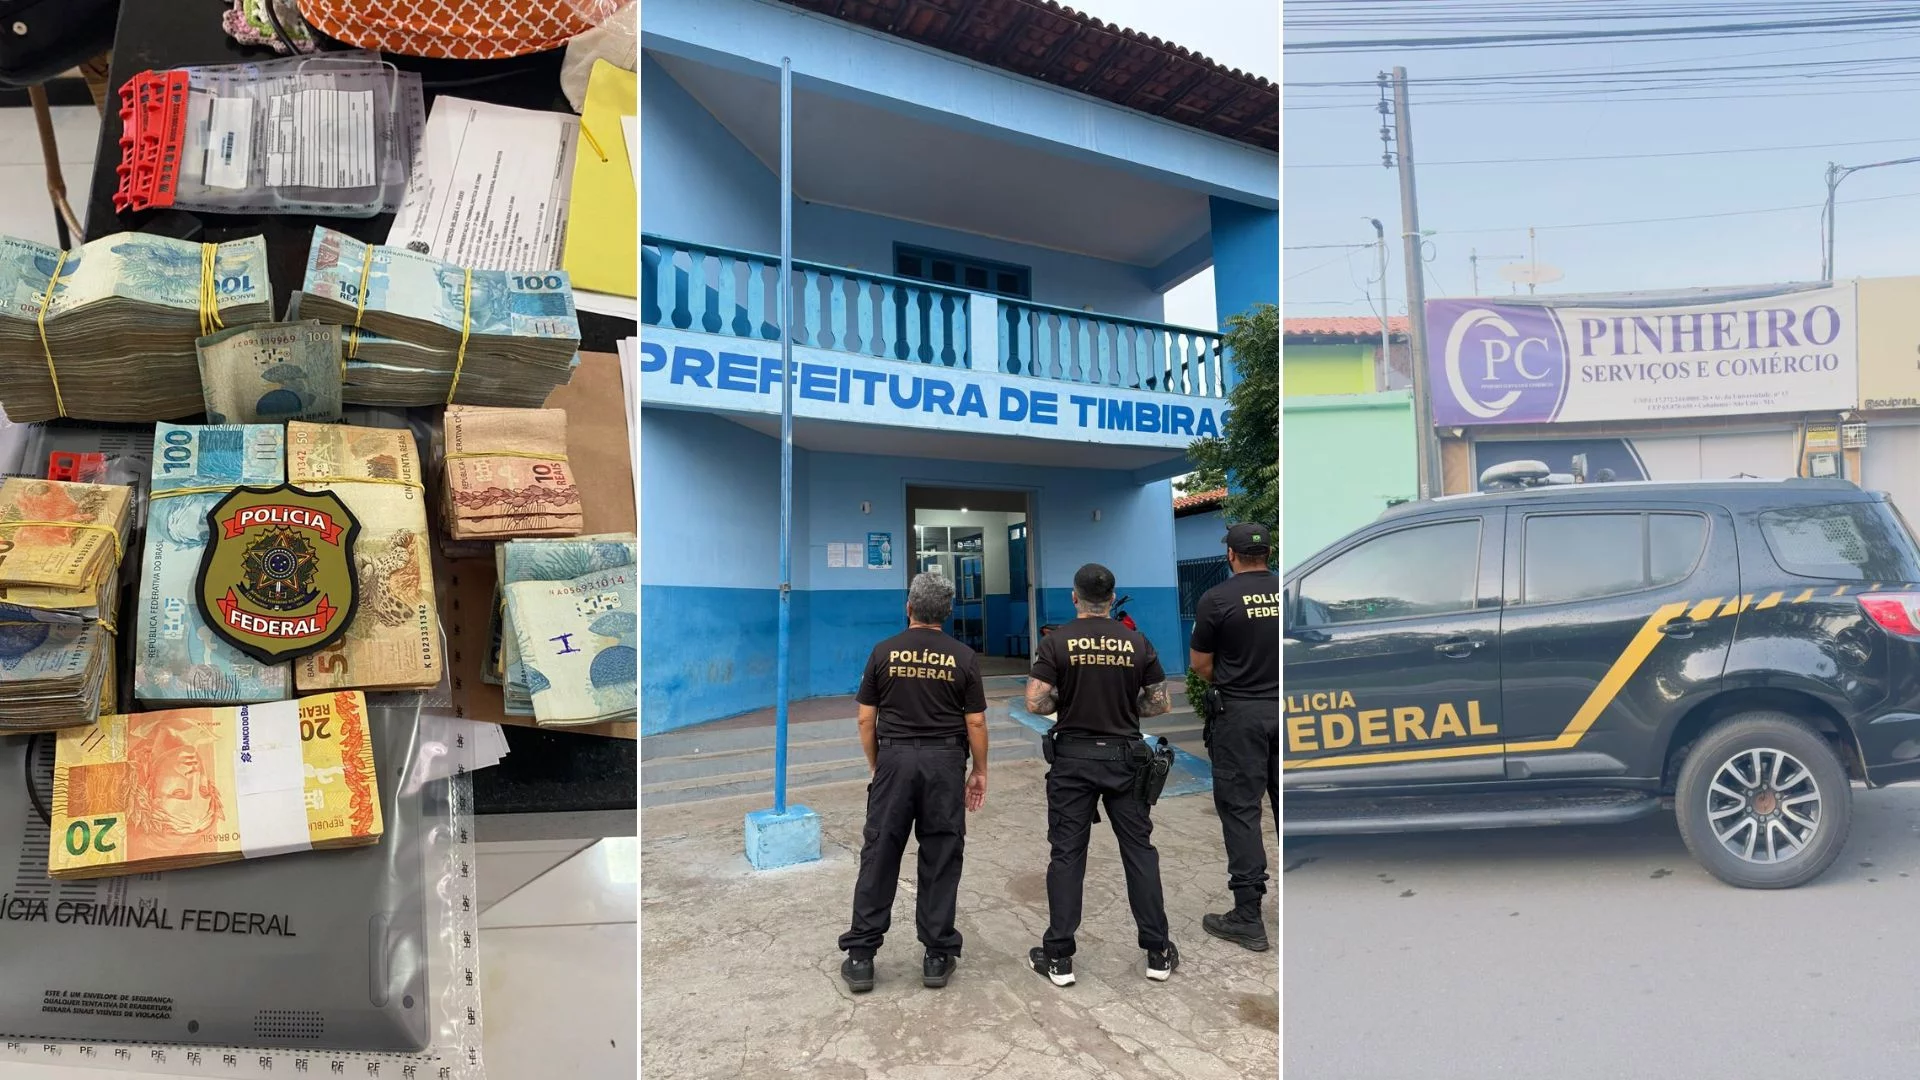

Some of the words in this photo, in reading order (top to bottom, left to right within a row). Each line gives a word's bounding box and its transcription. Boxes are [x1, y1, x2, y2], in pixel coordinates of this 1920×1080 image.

[512, 276, 562, 290] 100
[340, 292, 368, 306] REAS
[307, 332, 329, 342] 100
[1578, 305, 1840, 356] PINHEIRO
[1582, 361, 1690, 384] SERVIÇOS
[1697, 360, 1710, 378] E
[1716, 352, 1839, 377] COMÉRCIO
[1000, 386, 1058, 425] DE
[163, 430, 192, 474] 100
[398, 435, 406, 452] REAIS
[532, 464, 554, 484] 10
[551, 463, 566, 486] REAIS
[154, 561, 161, 571] DO
[1247, 606, 1279, 618] FEDE
[1067, 636, 1134, 653] POLÍCIA
[890, 648, 956, 668] POLÍCIA
[1070, 654, 1134, 667] FEDERAL
[889, 666, 955, 682] FEDERAL
[1283, 690, 1356, 713] LICIA
[300, 719, 331, 741] 20
[1287, 701, 1498, 752] EDERAL
[308, 818, 344, 830] REPÚBLI
[66, 818, 117, 855] 20
[55, 901, 173, 930] CRIMINAL
[181, 909, 296, 936] FEDERAL
[43, 998, 80, 1006] QUALQUER
[82, 1000, 117, 1008] TENTATIVA
[129, 1003, 172, 1012] REABERTURA
[83, 992, 117, 1000] ENVELOPE
